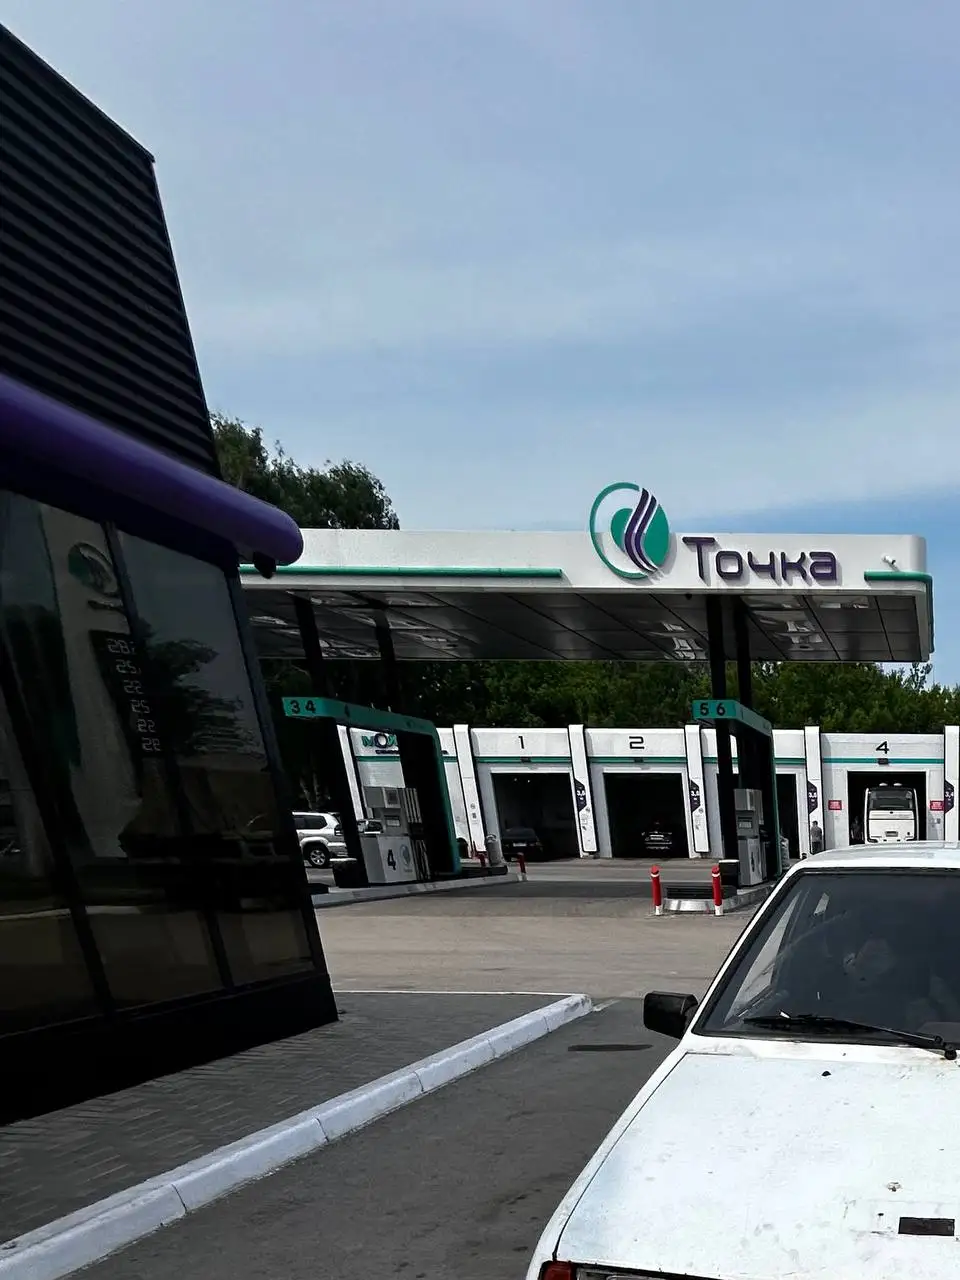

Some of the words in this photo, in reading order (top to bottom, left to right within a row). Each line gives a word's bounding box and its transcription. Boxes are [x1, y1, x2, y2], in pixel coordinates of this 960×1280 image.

[682, 536, 837, 581] Точка
[290, 700, 300, 714] 3
[305, 700, 316, 713] 4
[700, 702, 709, 716] 5
[716, 702, 726, 716] 6
[518, 735, 525, 749] 1
[628, 736, 645, 749] 2
[876, 741, 889, 754] 4
[387, 849, 396, 871] 4
